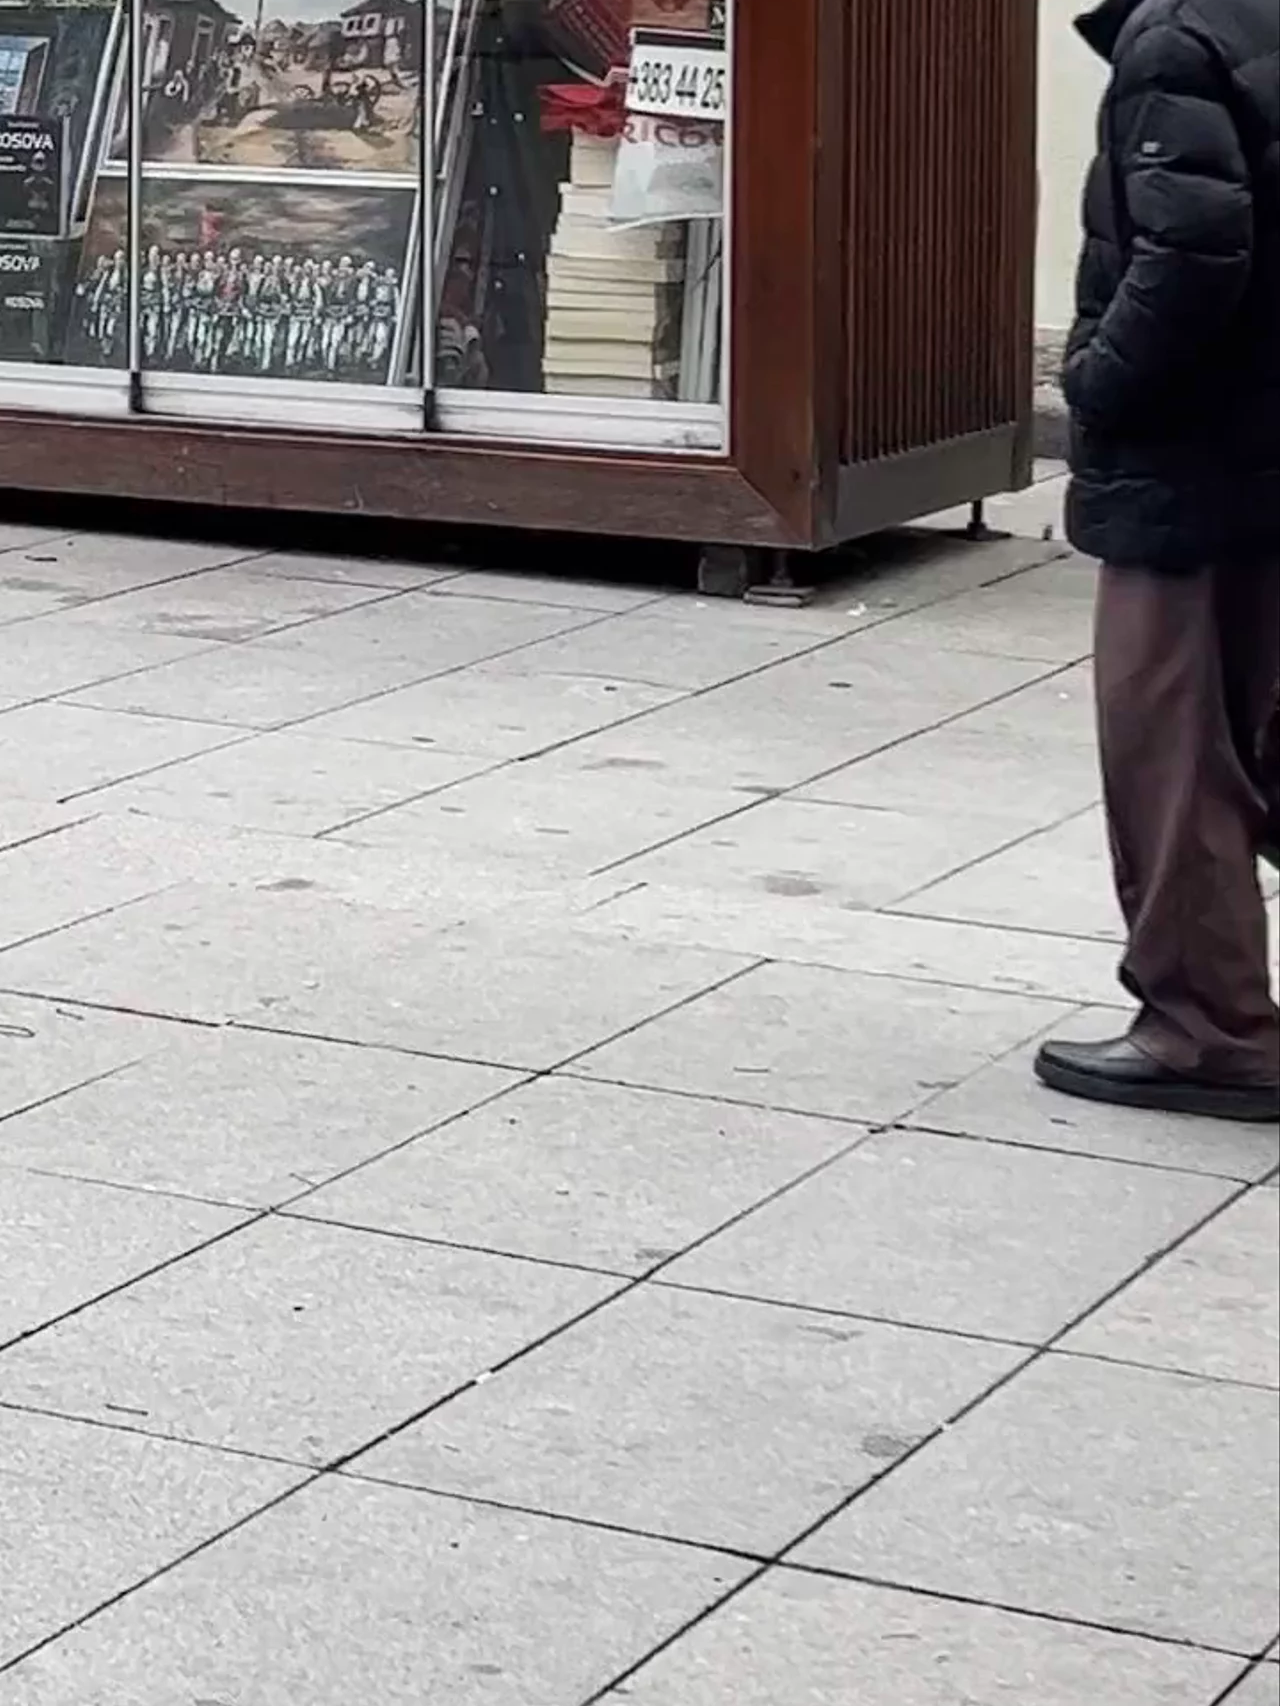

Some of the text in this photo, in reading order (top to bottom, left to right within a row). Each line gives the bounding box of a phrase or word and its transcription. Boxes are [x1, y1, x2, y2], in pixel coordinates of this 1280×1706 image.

[629, 60, 725, 110] +383 44 25
